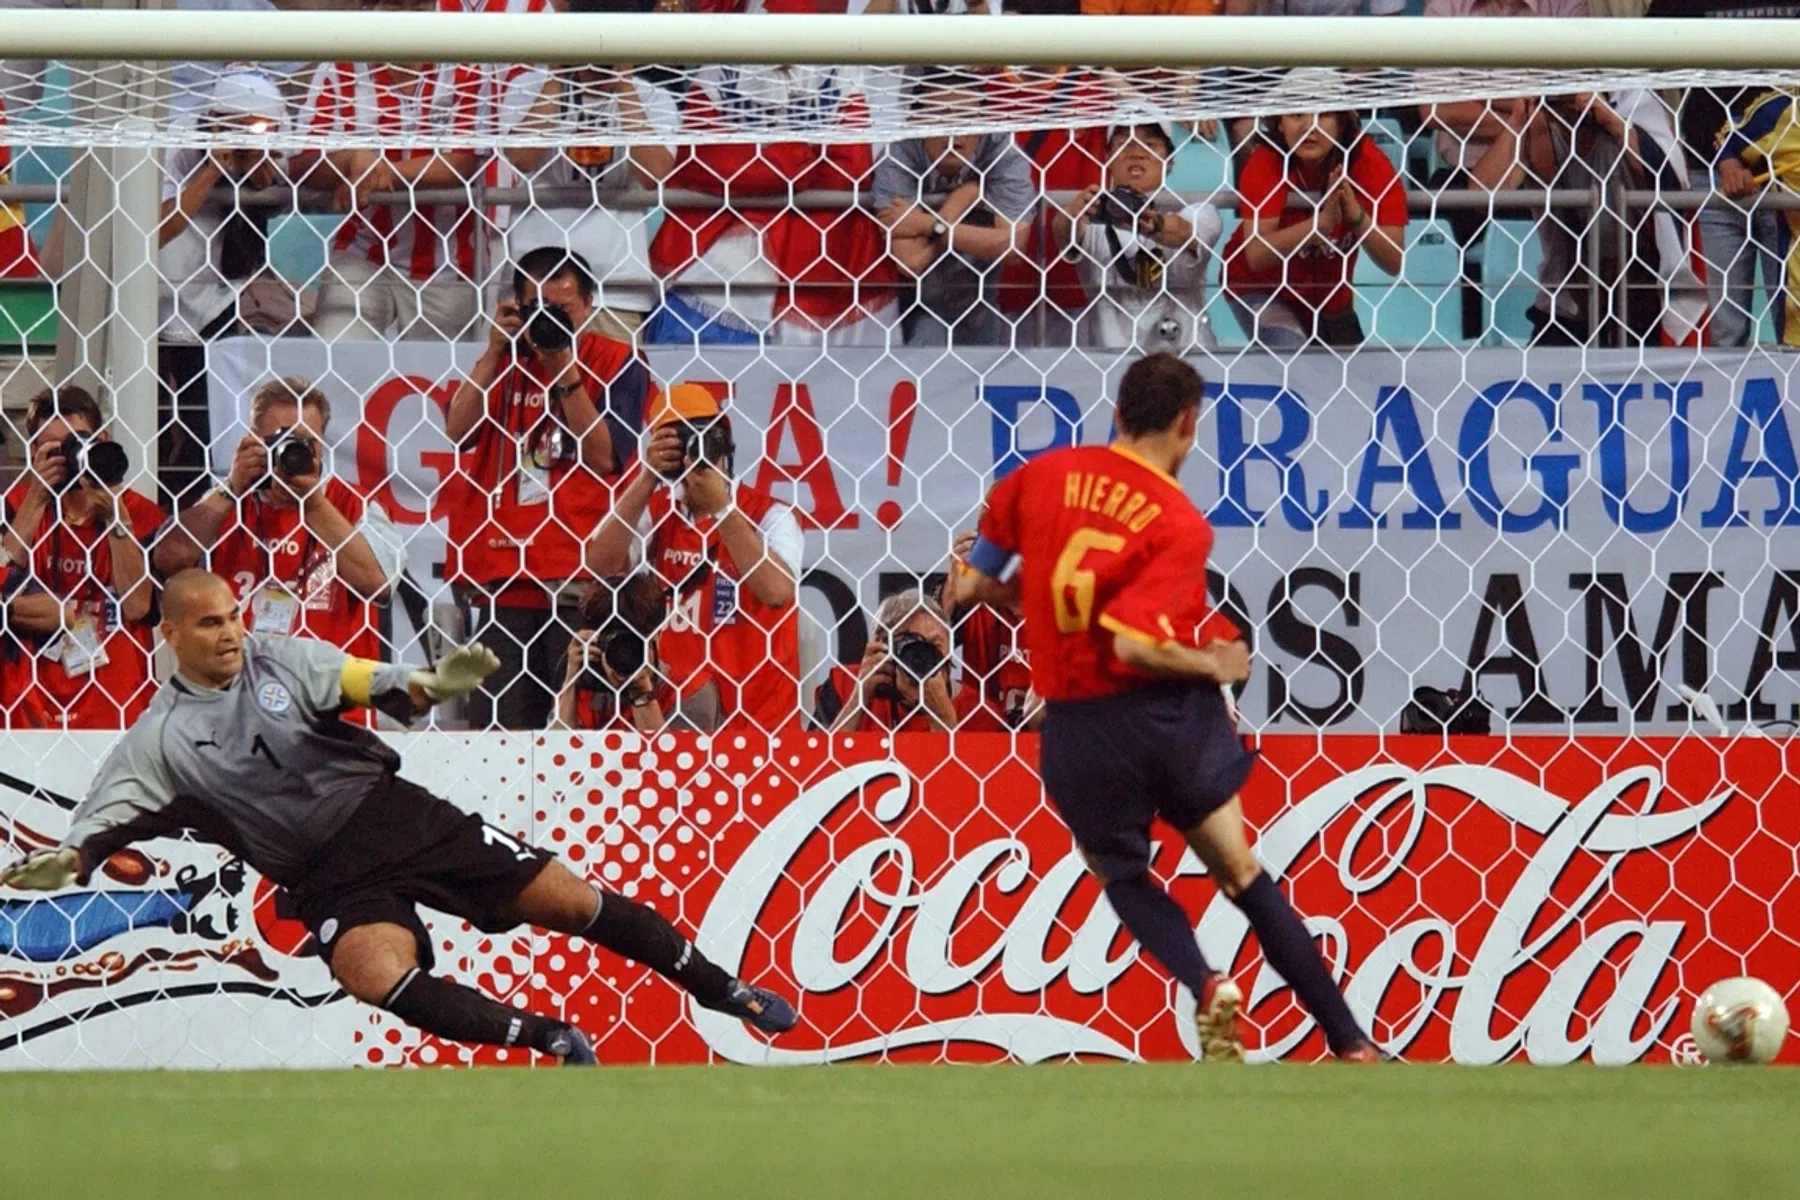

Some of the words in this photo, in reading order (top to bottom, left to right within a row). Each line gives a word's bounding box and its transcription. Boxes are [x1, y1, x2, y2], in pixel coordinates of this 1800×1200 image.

[974, 378, 1800, 533] PRAGUA
[1064, 471, 1163, 533] HIERRO
[1051, 526, 1126, 633] 6
[716, 601, 735, 616] 22
[251, 732, 282, 771] 1
[481, 824, 521, 854] 1
